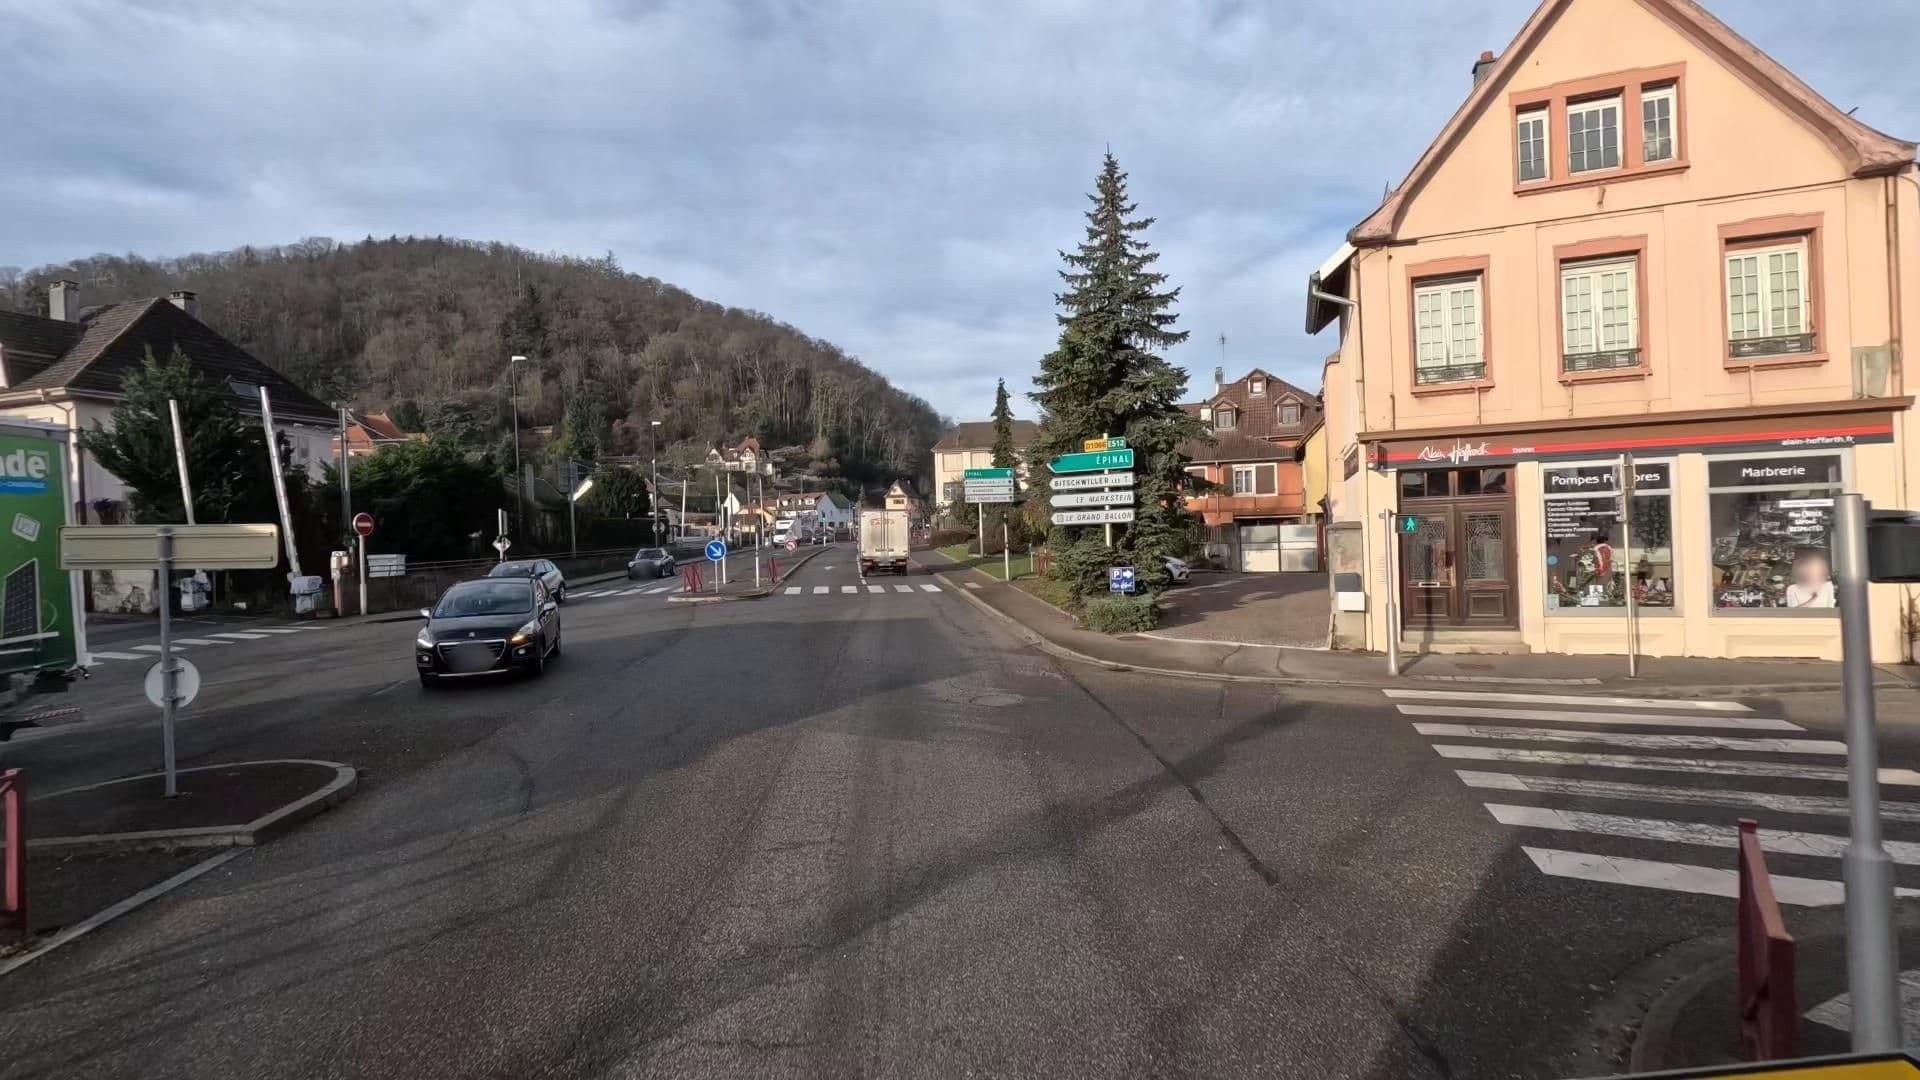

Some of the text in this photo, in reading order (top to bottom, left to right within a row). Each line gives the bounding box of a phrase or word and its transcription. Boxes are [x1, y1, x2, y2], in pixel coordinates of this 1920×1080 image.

[1096, 454, 1130, 465] ÉPINAL
[1742, 466, 1806, 477] Marbrerie
[1054, 476, 1109, 487] BITSCHWILLER
[1552, 475, 1600, 487] Pompes
[1088, 494, 1132, 503] MARKSTEIN
[1105, 512, 1132, 520] BALLON
